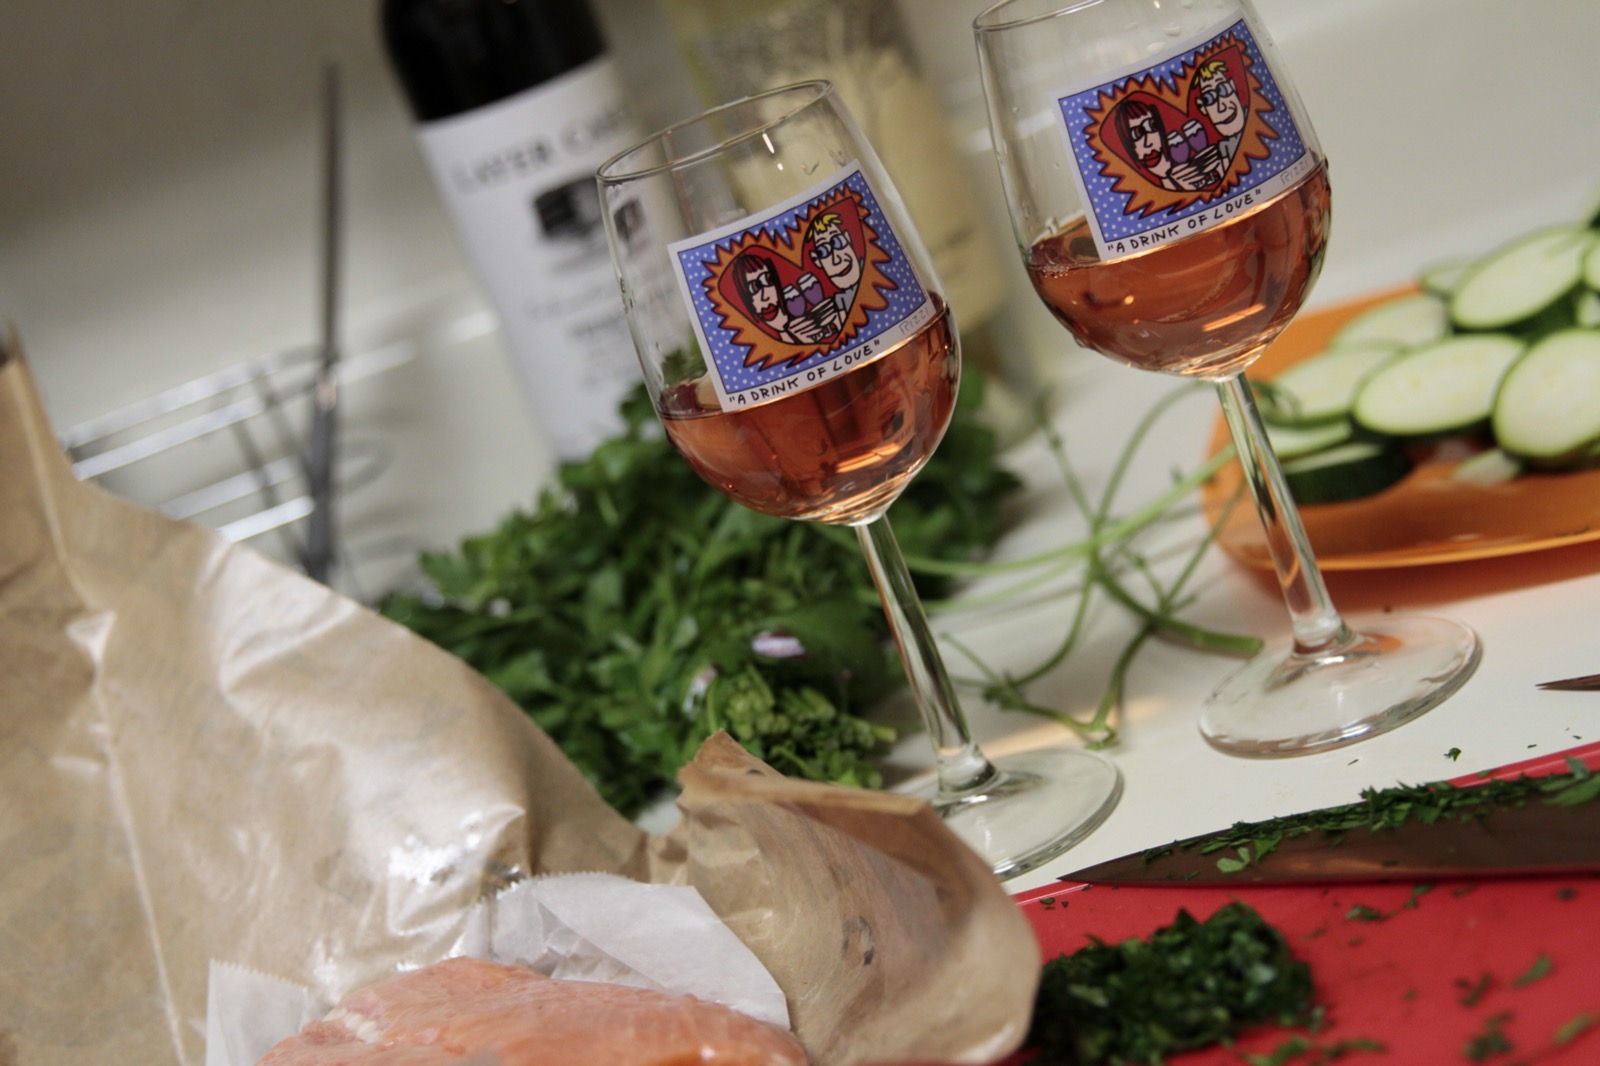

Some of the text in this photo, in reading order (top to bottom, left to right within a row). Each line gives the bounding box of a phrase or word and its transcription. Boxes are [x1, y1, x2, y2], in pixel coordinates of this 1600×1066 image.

[1130, 224, 1180, 250] DRINK
[1187, 215, 1208, 230] OF
[752, 376, 800, 401] DRINK
[806, 366, 827, 382] OF
